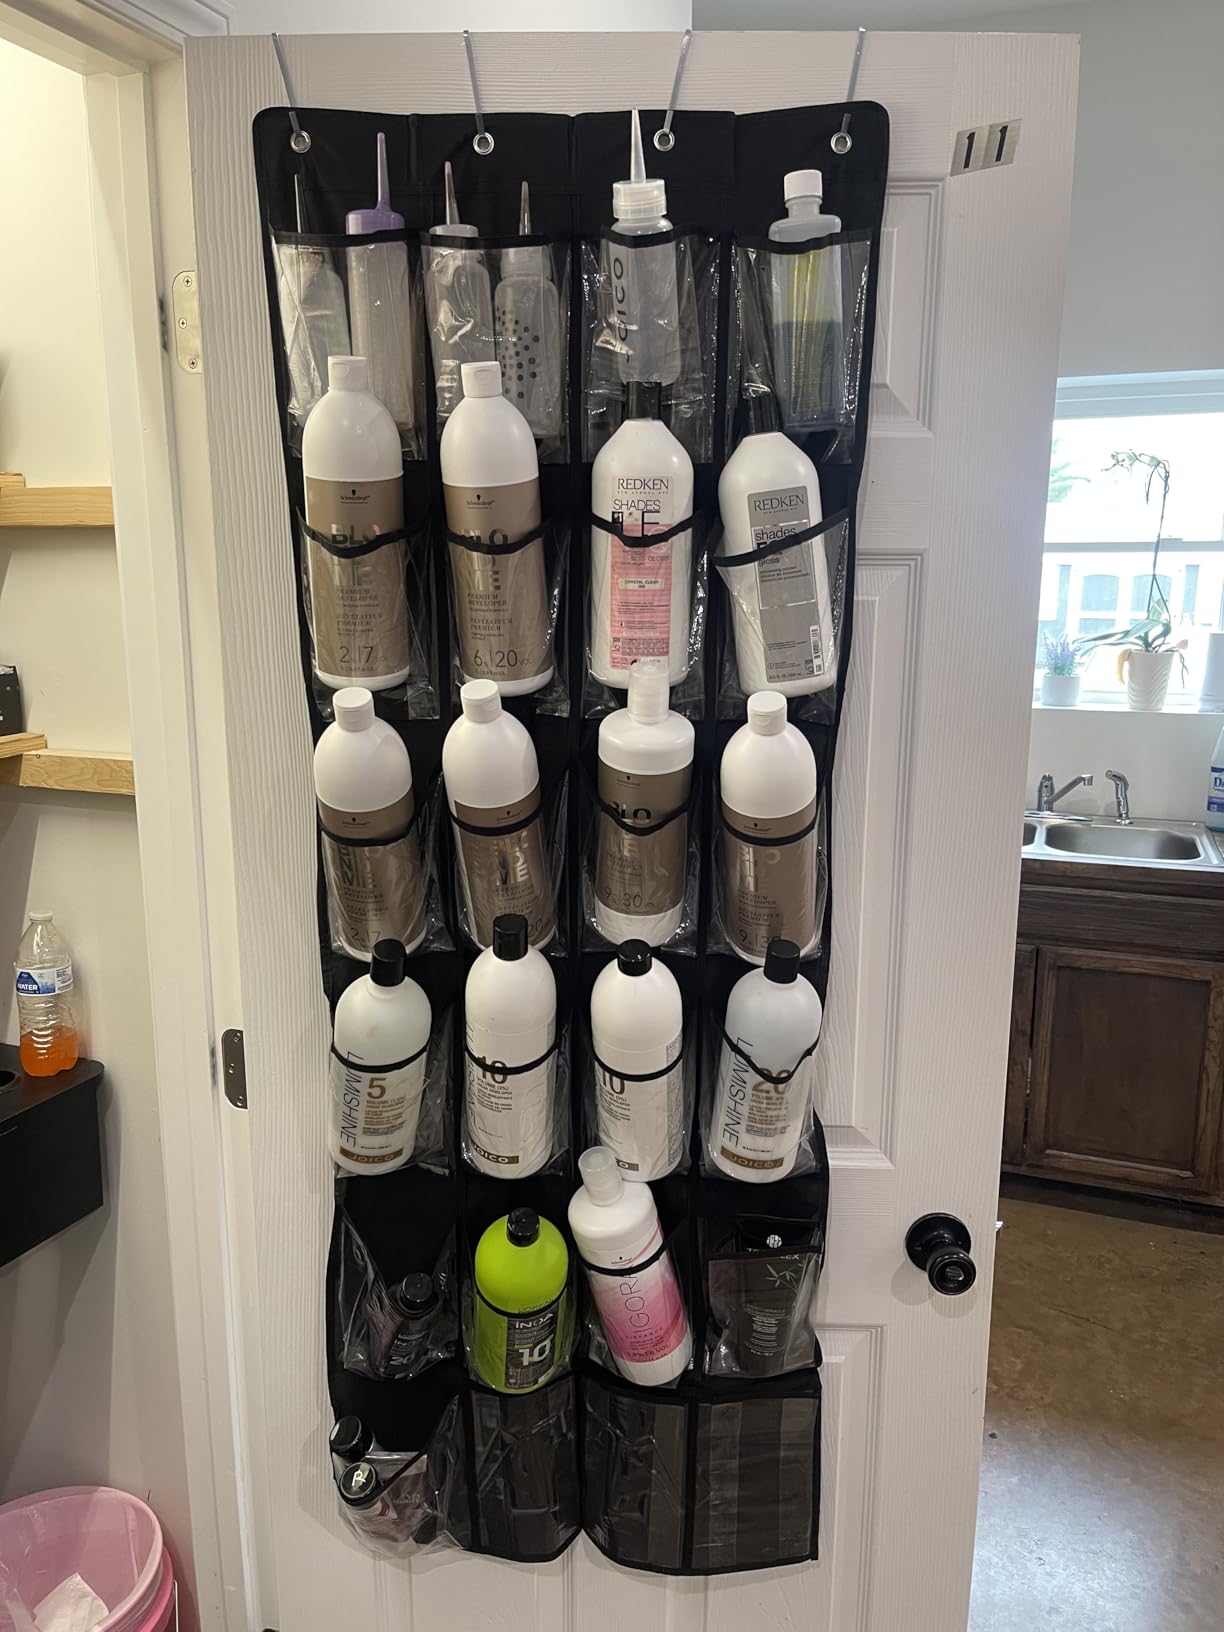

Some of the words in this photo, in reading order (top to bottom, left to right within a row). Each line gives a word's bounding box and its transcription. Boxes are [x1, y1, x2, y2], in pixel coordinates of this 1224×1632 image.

[617, 478, 669, 490] REDKEN
[613, 498, 661, 511] SHADES
[753, 494, 805, 512] REDKEN
[755, 527, 797, 542] shades
[367, 1077, 387, 1100] 5
[722, 1036, 753, 1148] LUMISHINE
[732, 1155, 780, 1167] JOICO
[518, 1334, 555, 1367] 10
